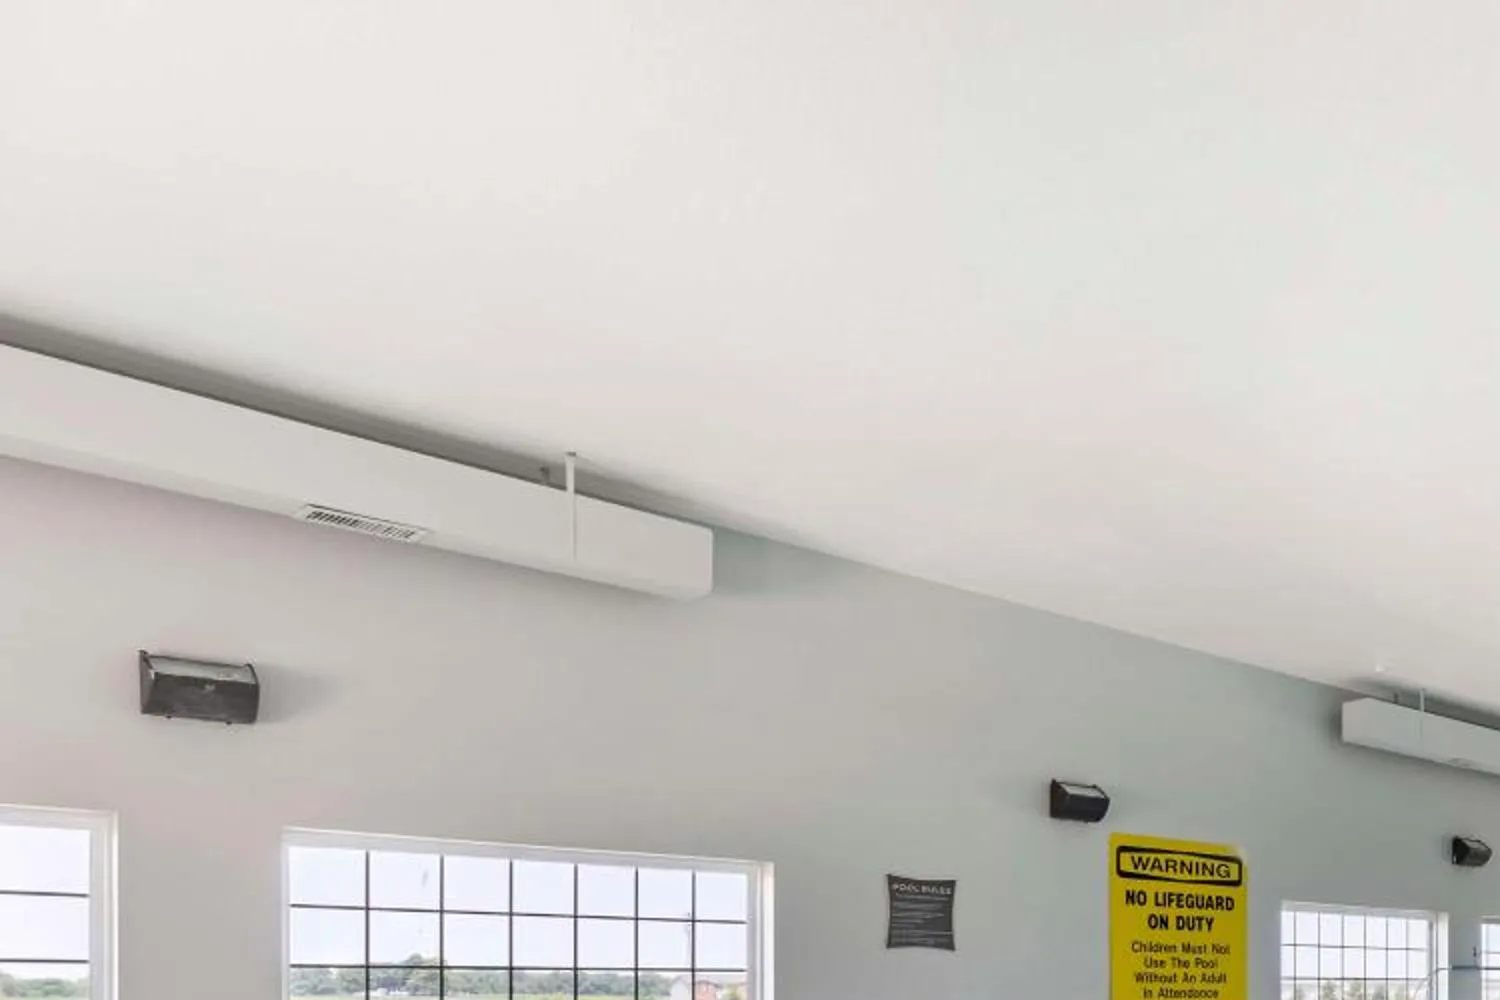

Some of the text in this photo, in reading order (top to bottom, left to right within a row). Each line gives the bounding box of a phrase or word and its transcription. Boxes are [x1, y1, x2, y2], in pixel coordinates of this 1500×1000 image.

[1130, 855, 1231, 879] WARNING
[1125, 889, 1235, 911] NO LIFEGUARD
[1147, 913, 1214, 932] ON DUTY
[1131, 940, 1231, 956] Children Must Not
[1143, 957, 1219, 969] Use The Pool
[1134, 971, 1228, 985] Without An Adult
[1143, 986, 1219, 1000] In Attendance
